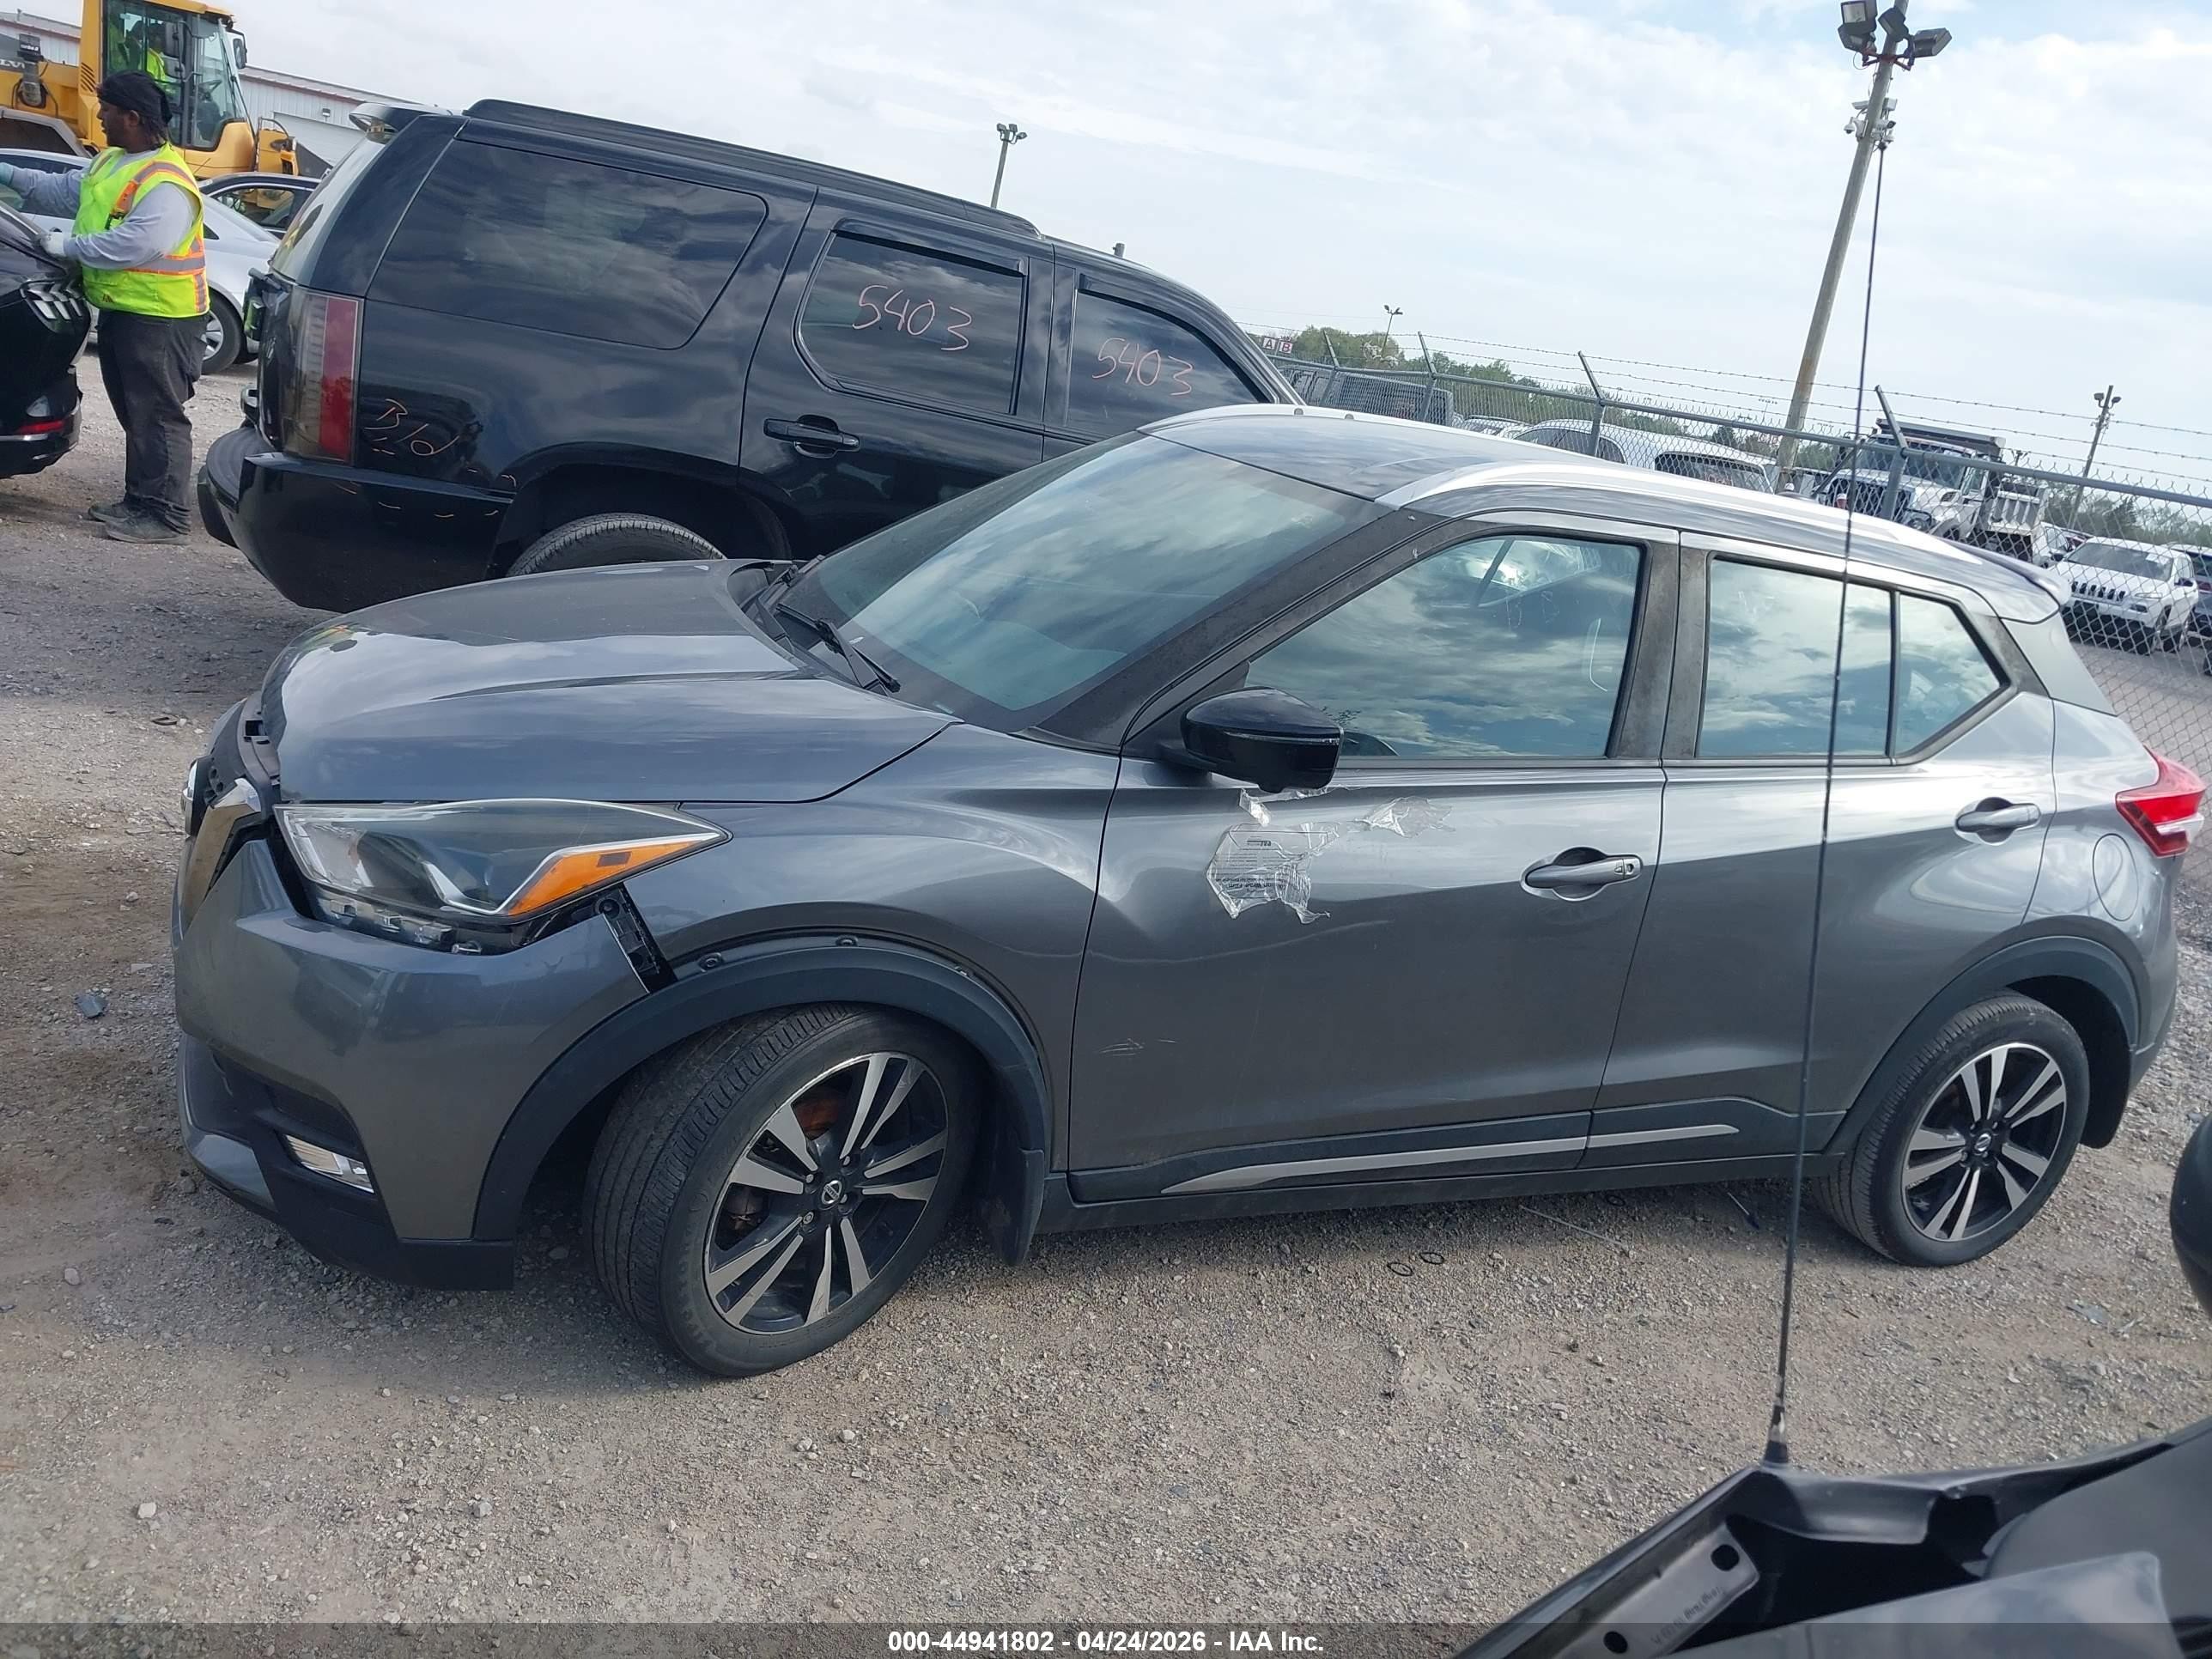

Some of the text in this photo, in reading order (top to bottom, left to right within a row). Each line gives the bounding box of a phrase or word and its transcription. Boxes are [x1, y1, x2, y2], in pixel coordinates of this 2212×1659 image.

[852, 284, 972, 350] 5403
[1265, 338, 1291, 352] A B
[1092, 337, 1194, 395] 5403
